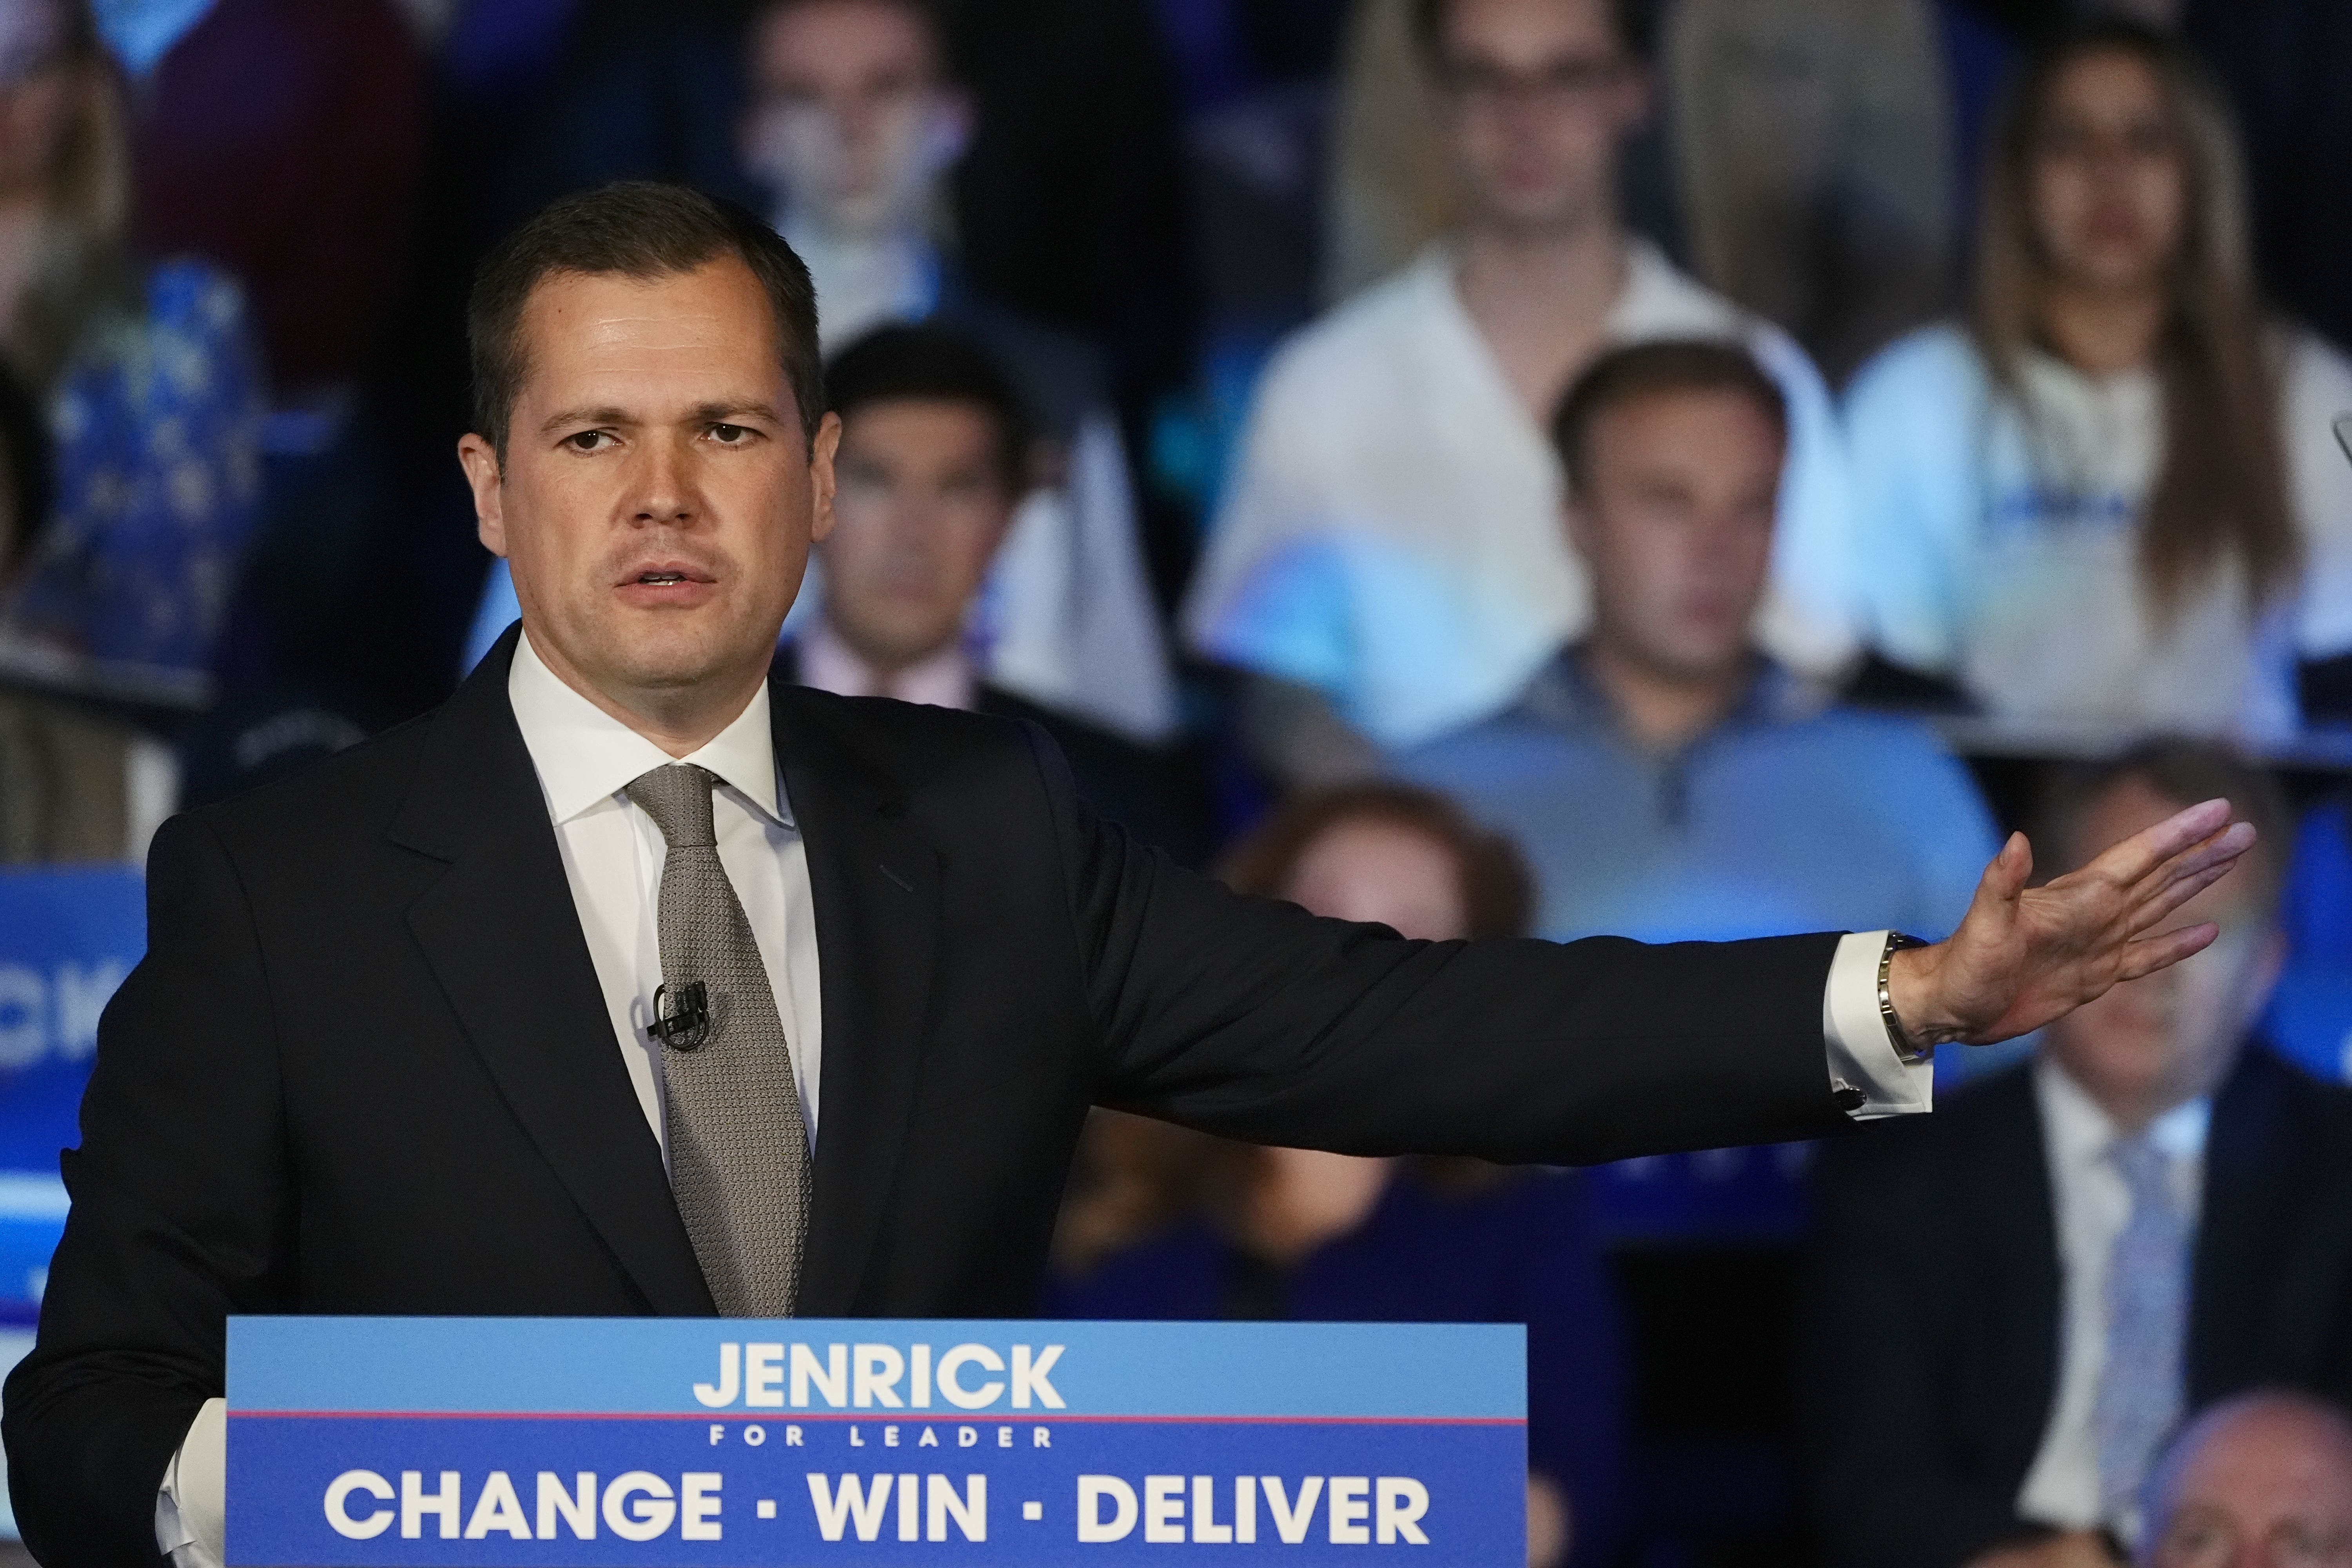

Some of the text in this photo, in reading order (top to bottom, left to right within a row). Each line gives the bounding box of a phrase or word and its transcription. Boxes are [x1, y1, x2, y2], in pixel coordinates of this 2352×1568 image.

[693, 1342, 1067, 1410] JENRICK
[710, 1425, 1051, 1448] FOR LEADER
[324, 1469, 1429, 1544] CHANGE WIN DELIVER
